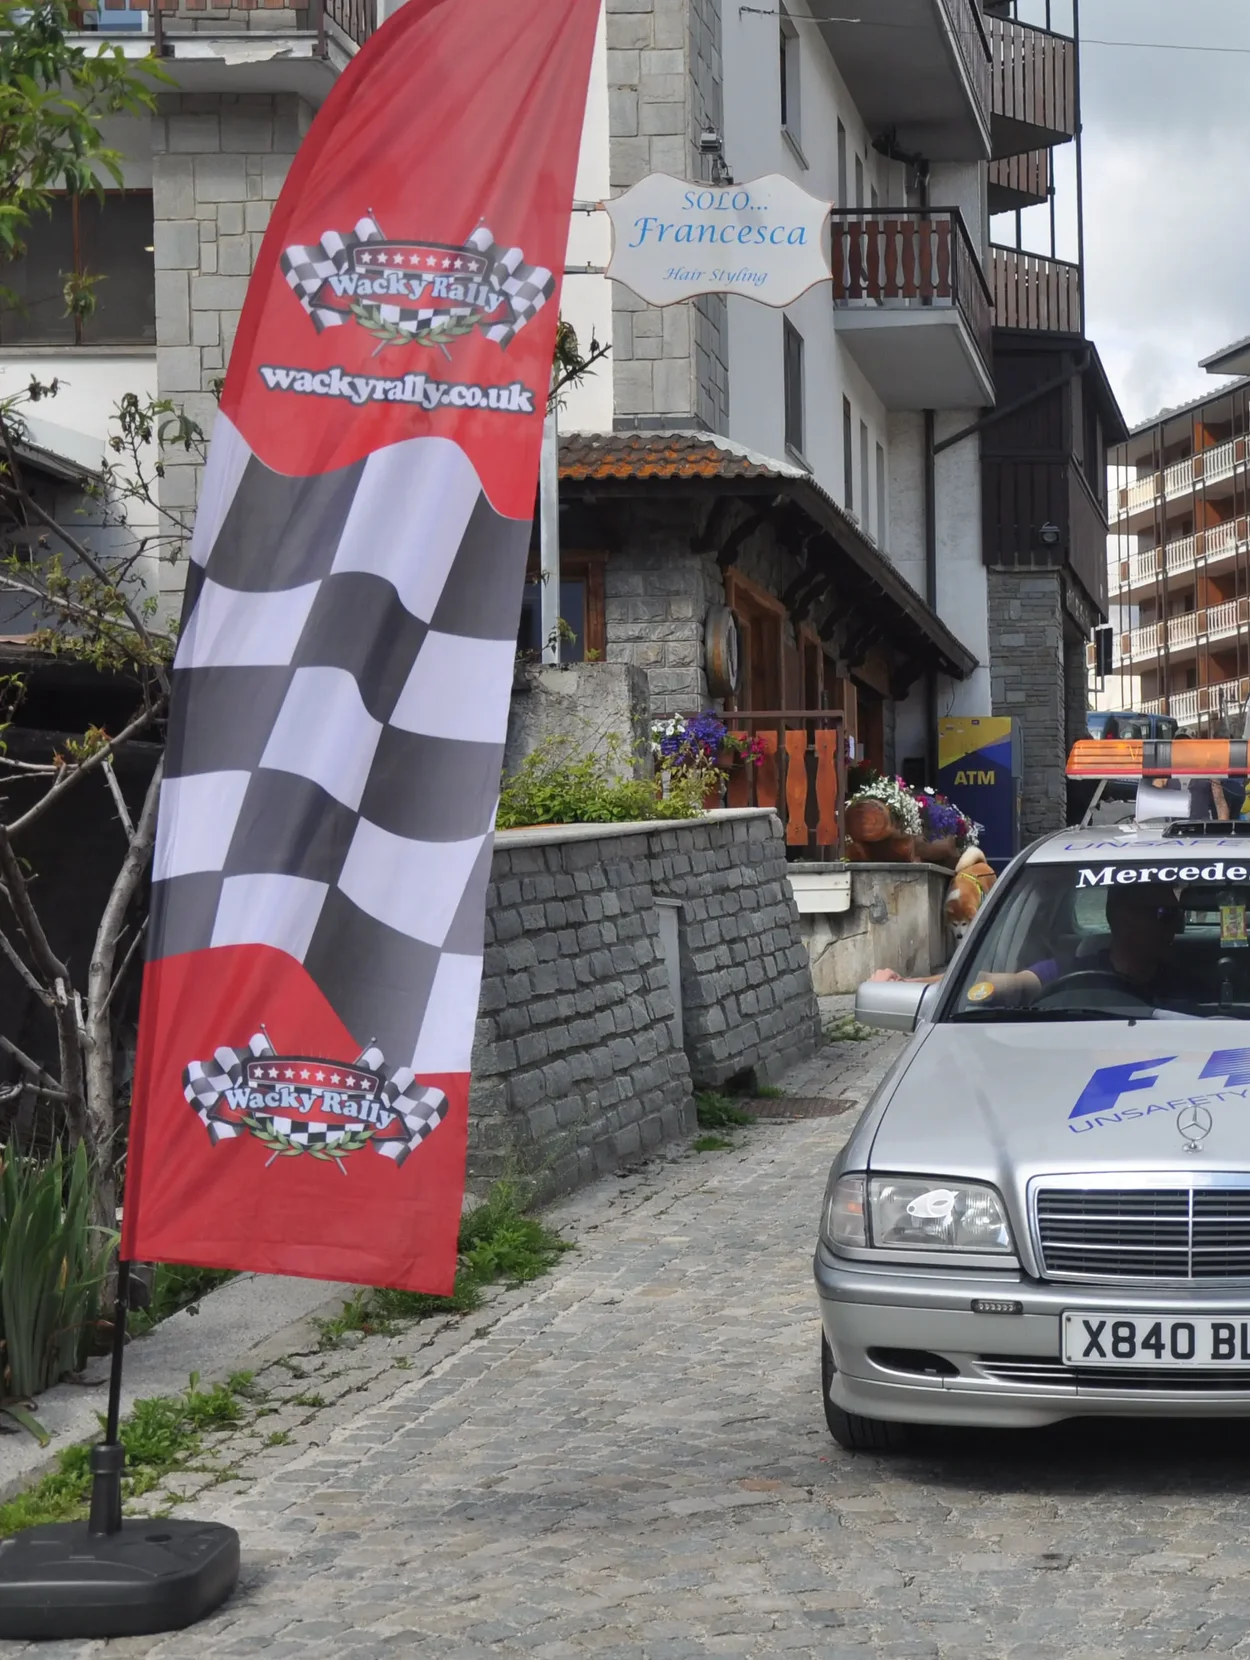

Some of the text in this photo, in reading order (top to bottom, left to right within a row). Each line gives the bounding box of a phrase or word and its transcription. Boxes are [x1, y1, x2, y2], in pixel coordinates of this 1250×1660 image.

[681, 191, 768, 211] SOLO...
[628, 217, 808, 248] Francesca
[328, 272, 504, 313] Wacky Rally
[662, 267, 768, 287] Hair Styling
[259, 365, 535, 413] wackyrally.co.uk
[953, 770, 996, 785] ATM
[224, 1085, 397, 1130] Wacky Rally
[1068, 1088, 1248, 1134] UNSAFETY
[1082, 1319, 1196, 1360] X840
